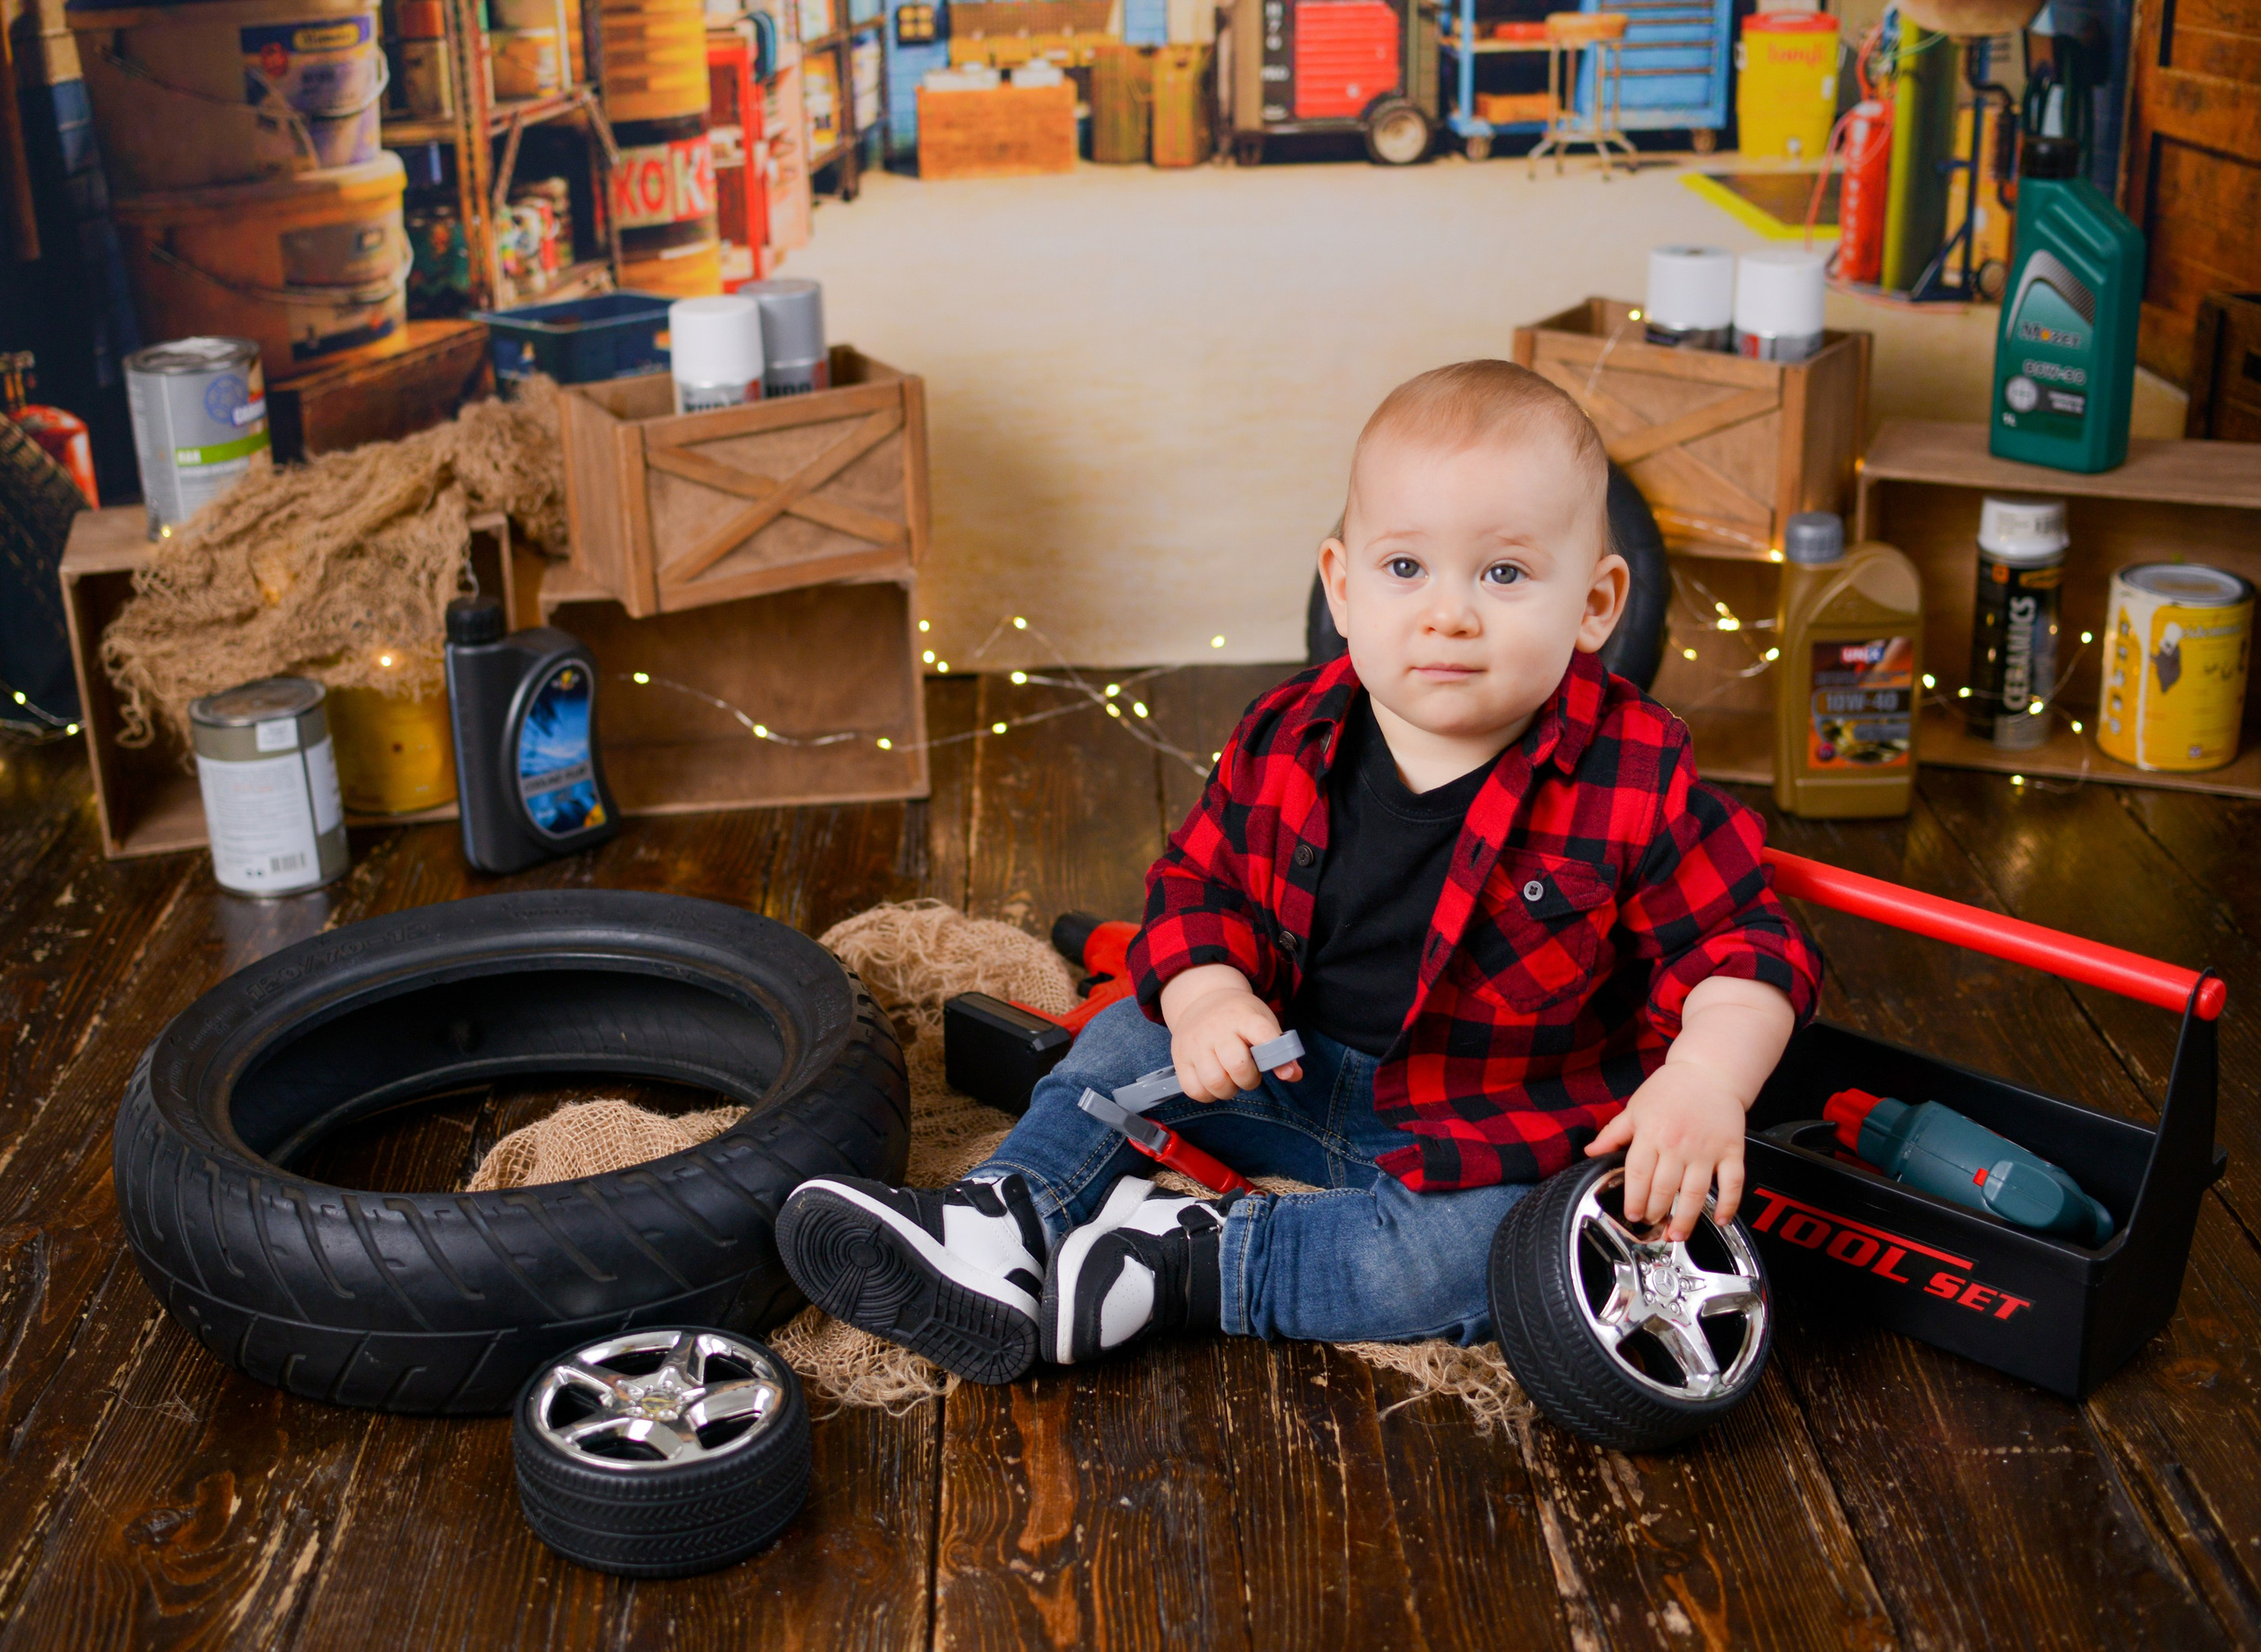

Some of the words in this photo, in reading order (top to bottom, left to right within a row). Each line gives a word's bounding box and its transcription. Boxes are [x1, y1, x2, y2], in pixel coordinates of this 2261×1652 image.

[2003, 596, 2037, 710] CERAMICS
[1752, 1188, 1973, 1283] TOOL
[1924, 1272, 2030, 1320] SET
